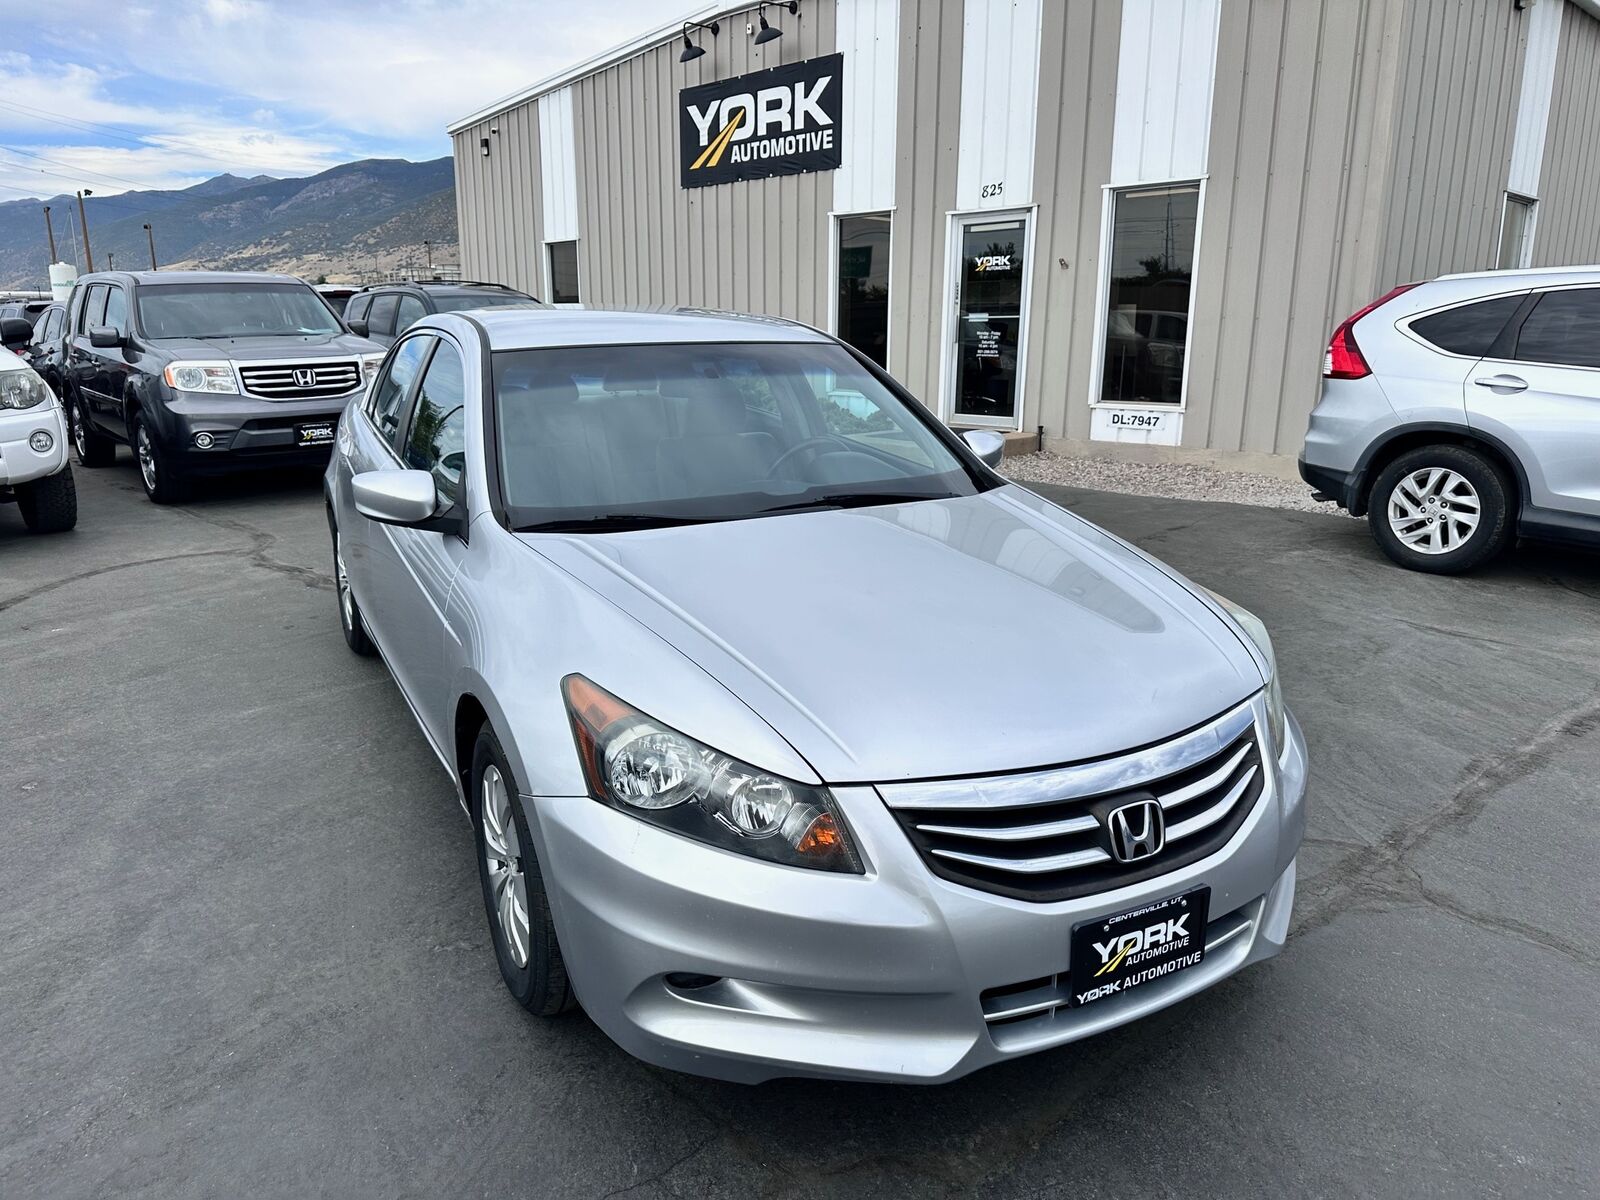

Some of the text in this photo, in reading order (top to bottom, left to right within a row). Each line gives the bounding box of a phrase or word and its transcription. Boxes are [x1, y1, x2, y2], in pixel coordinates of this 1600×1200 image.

[686, 75, 834, 147] YORK
[730, 128, 833, 164] AUTOMOTIVE
[981, 181, 1003, 199] 825
[974, 255, 1011, 267] YORK
[300, 428, 333, 437] YORK
[1112, 414, 1160, 427] DL:7947
[1108, 895, 1184, 925] CENTERVILLE, UT
[1092, 912, 1191, 964] YORK
[1125, 936, 1190, 967] AUTOMOTIVE
[1076, 951, 1202, 1005] YORK AUTOMOTIVE
